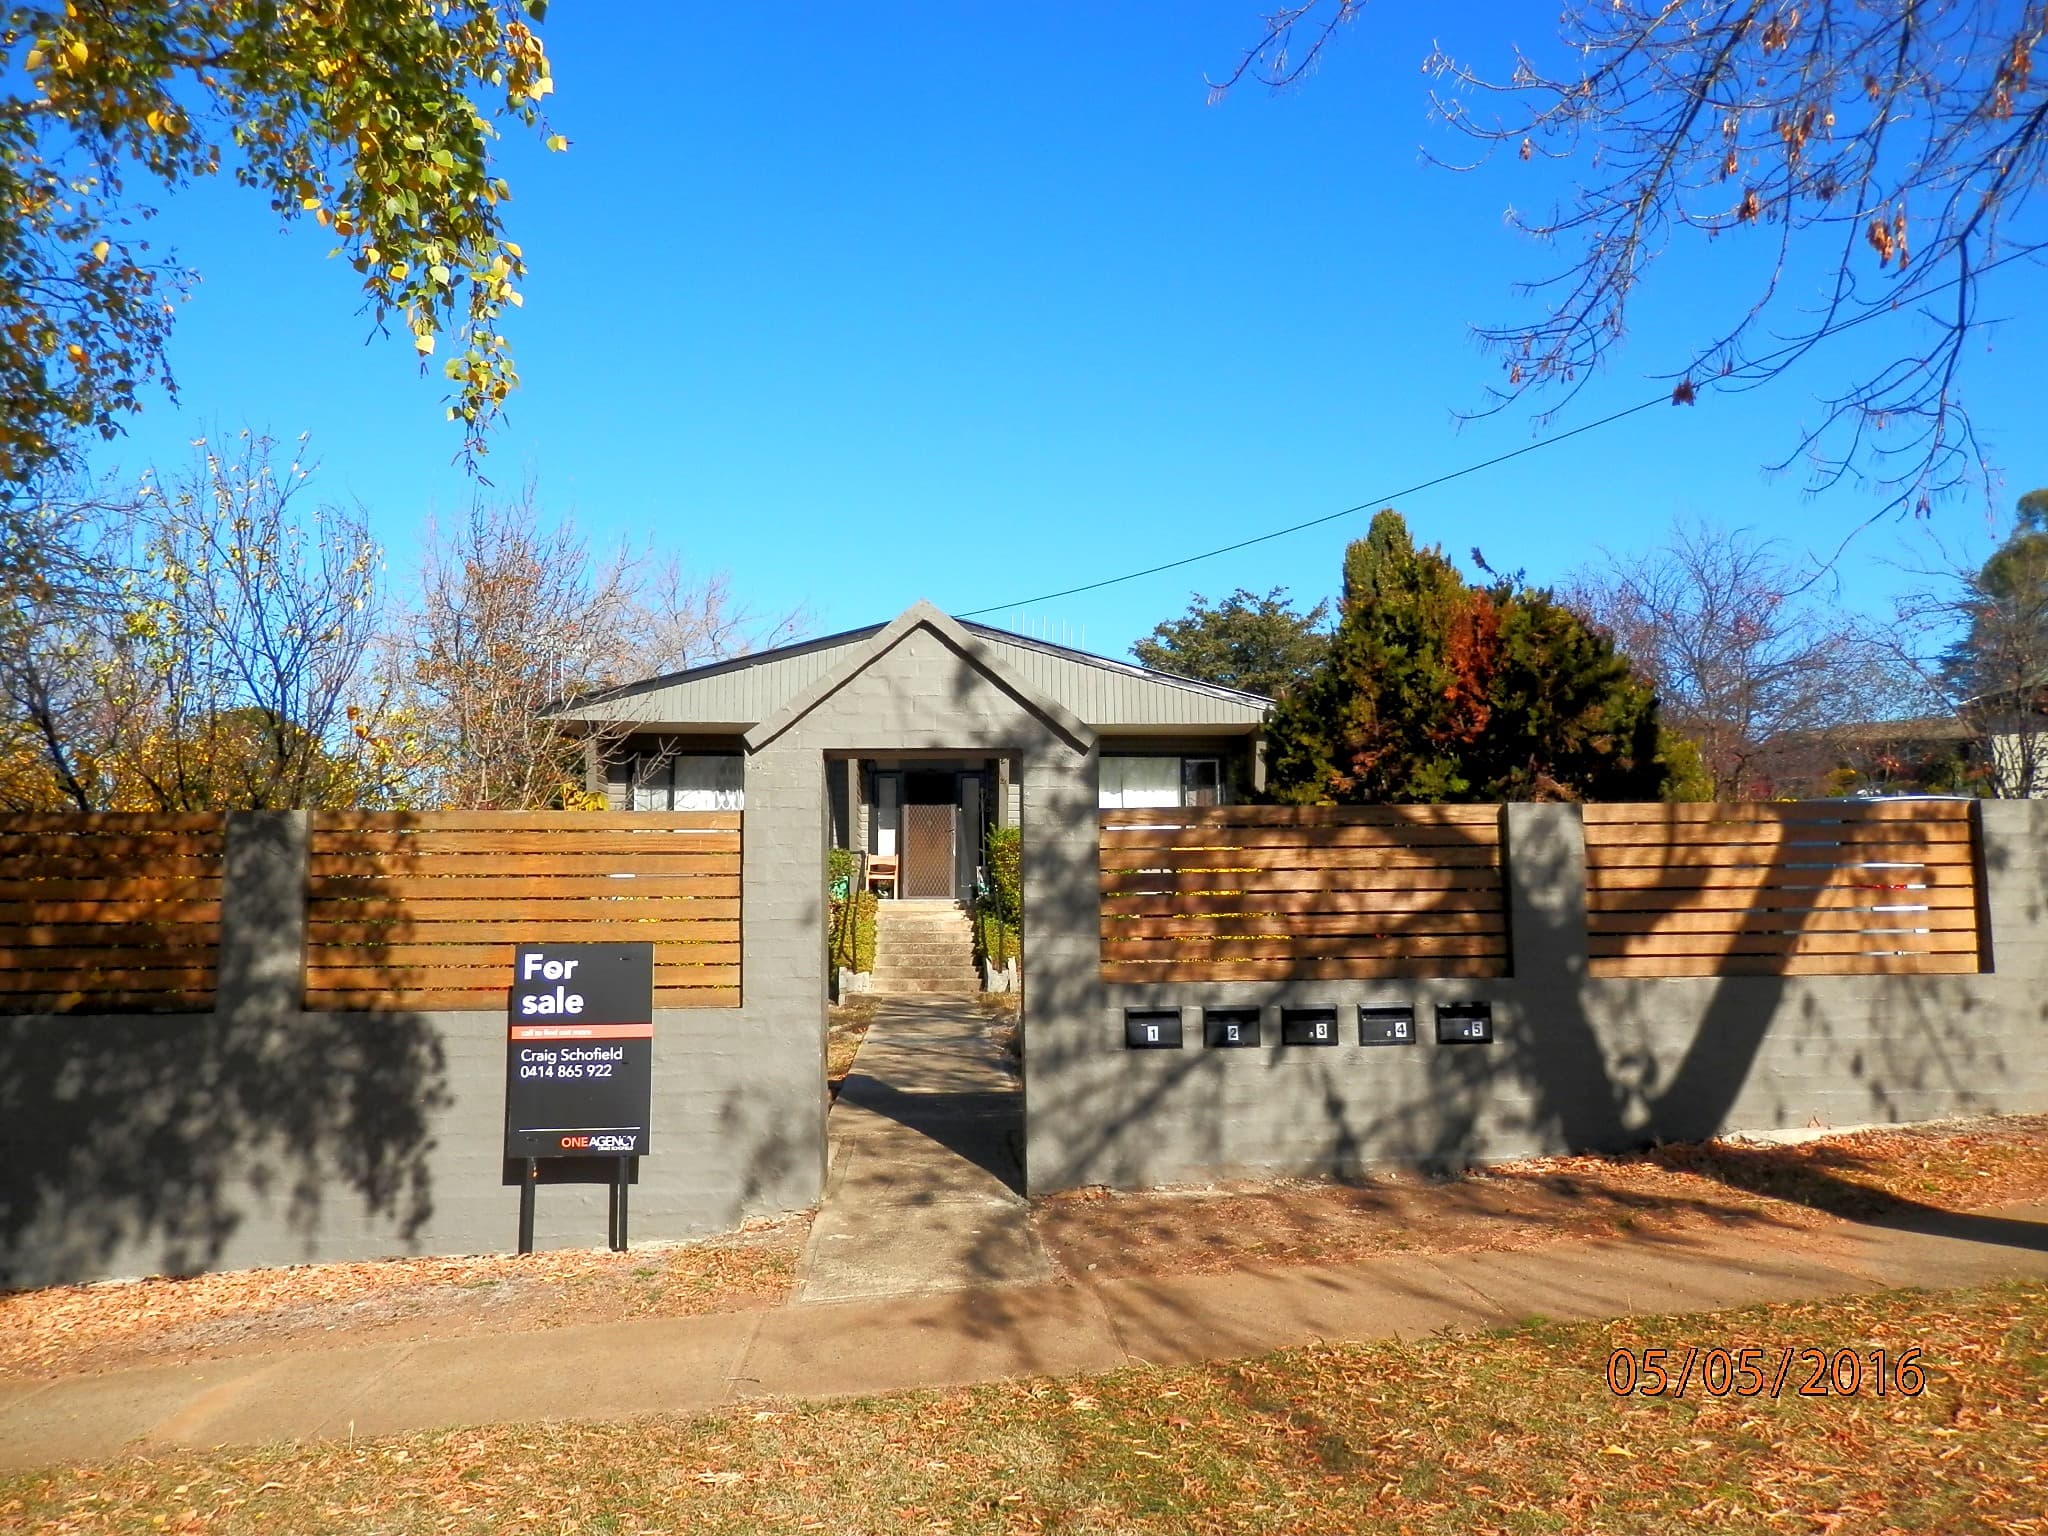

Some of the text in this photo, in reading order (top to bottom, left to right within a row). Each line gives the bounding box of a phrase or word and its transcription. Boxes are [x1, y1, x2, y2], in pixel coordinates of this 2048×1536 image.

[524, 953, 579, 980] For
[521, 985, 584, 1014] sale
[1229, 1027, 1238, 1039] 2
[1318, 1024, 1326, 1036] 3
[1396, 1023, 1406, 1035] 4
[520, 1046, 623, 1065] Craig Schofield
[520, 1063, 612, 1078] 0414 865 922
